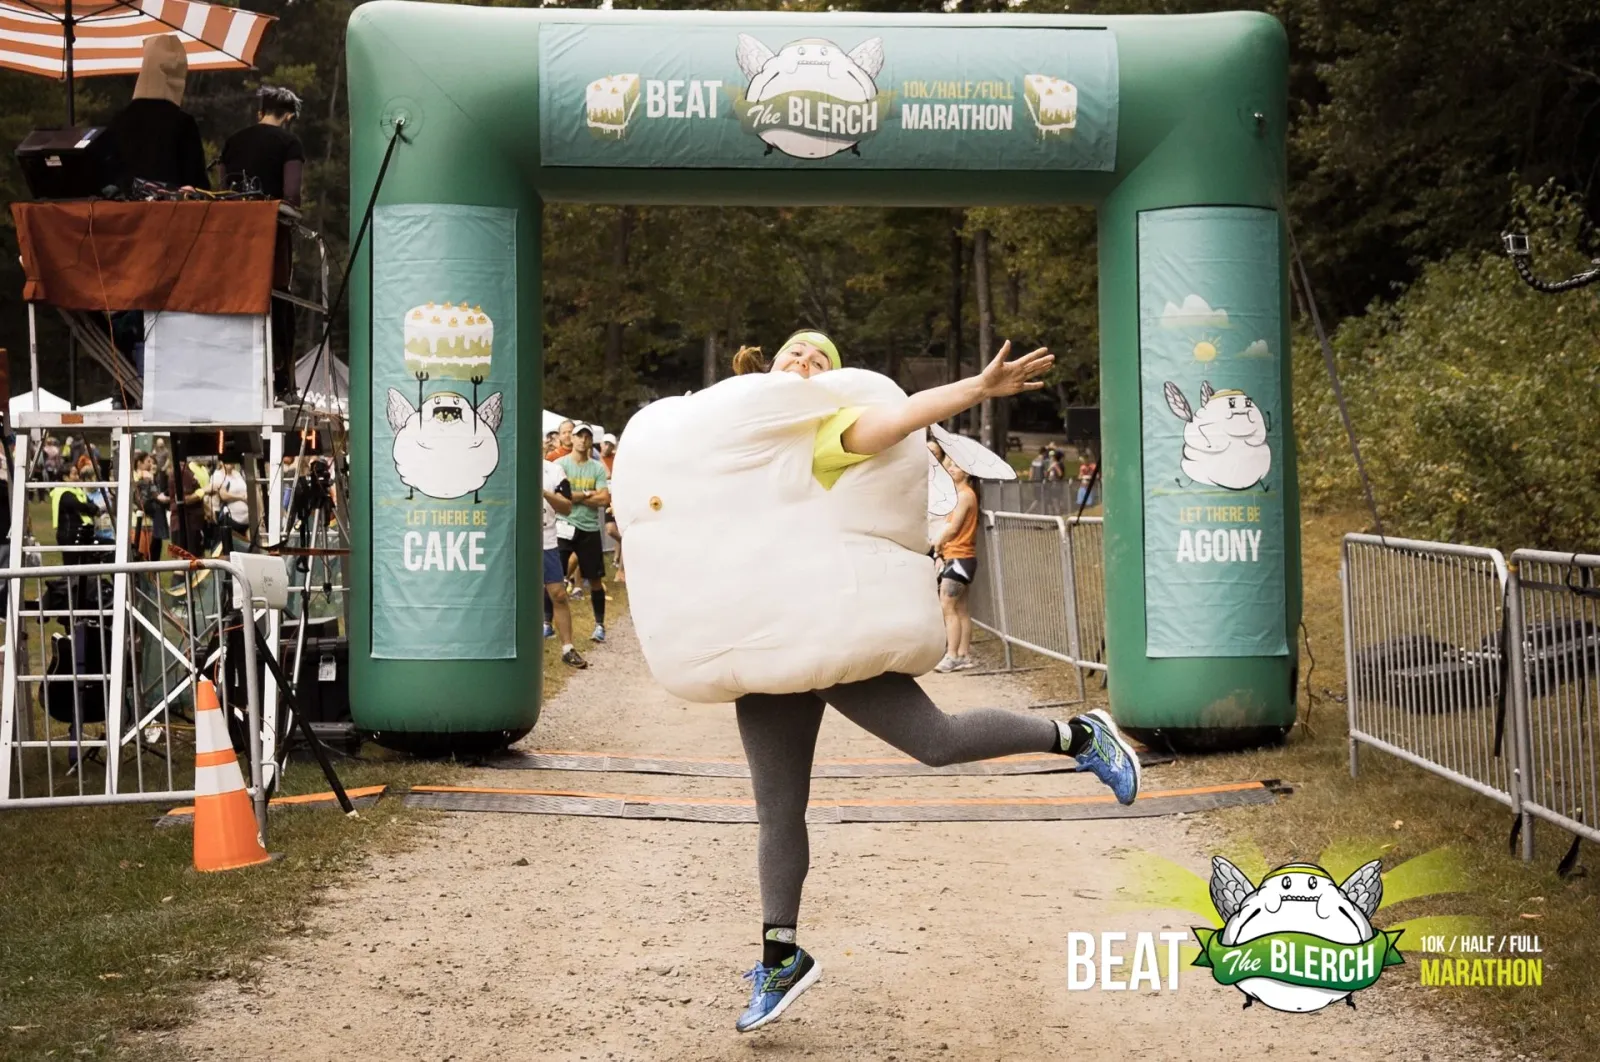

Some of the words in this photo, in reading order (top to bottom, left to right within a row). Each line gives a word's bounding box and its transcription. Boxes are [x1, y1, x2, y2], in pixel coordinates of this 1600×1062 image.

[645, 79, 723, 119] BEAT
[902, 80, 1015, 101] 10K/HALF/FULL
[746, 103, 781, 128] The
[787, 95, 878, 136] BLERCH
[901, 103, 1014, 131] MARATHON
[406, 509, 427, 526] LET
[430, 509, 469, 526] THERE
[472, 509, 488, 526] BE
[1180, 506, 1202, 523] LET
[1205, 506, 1244, 523] THERE
[1247, 506, 1261, 523] BE
[403, 530, 487, 572] CAKE
[1176, 528, 1263, 563] AGONY
